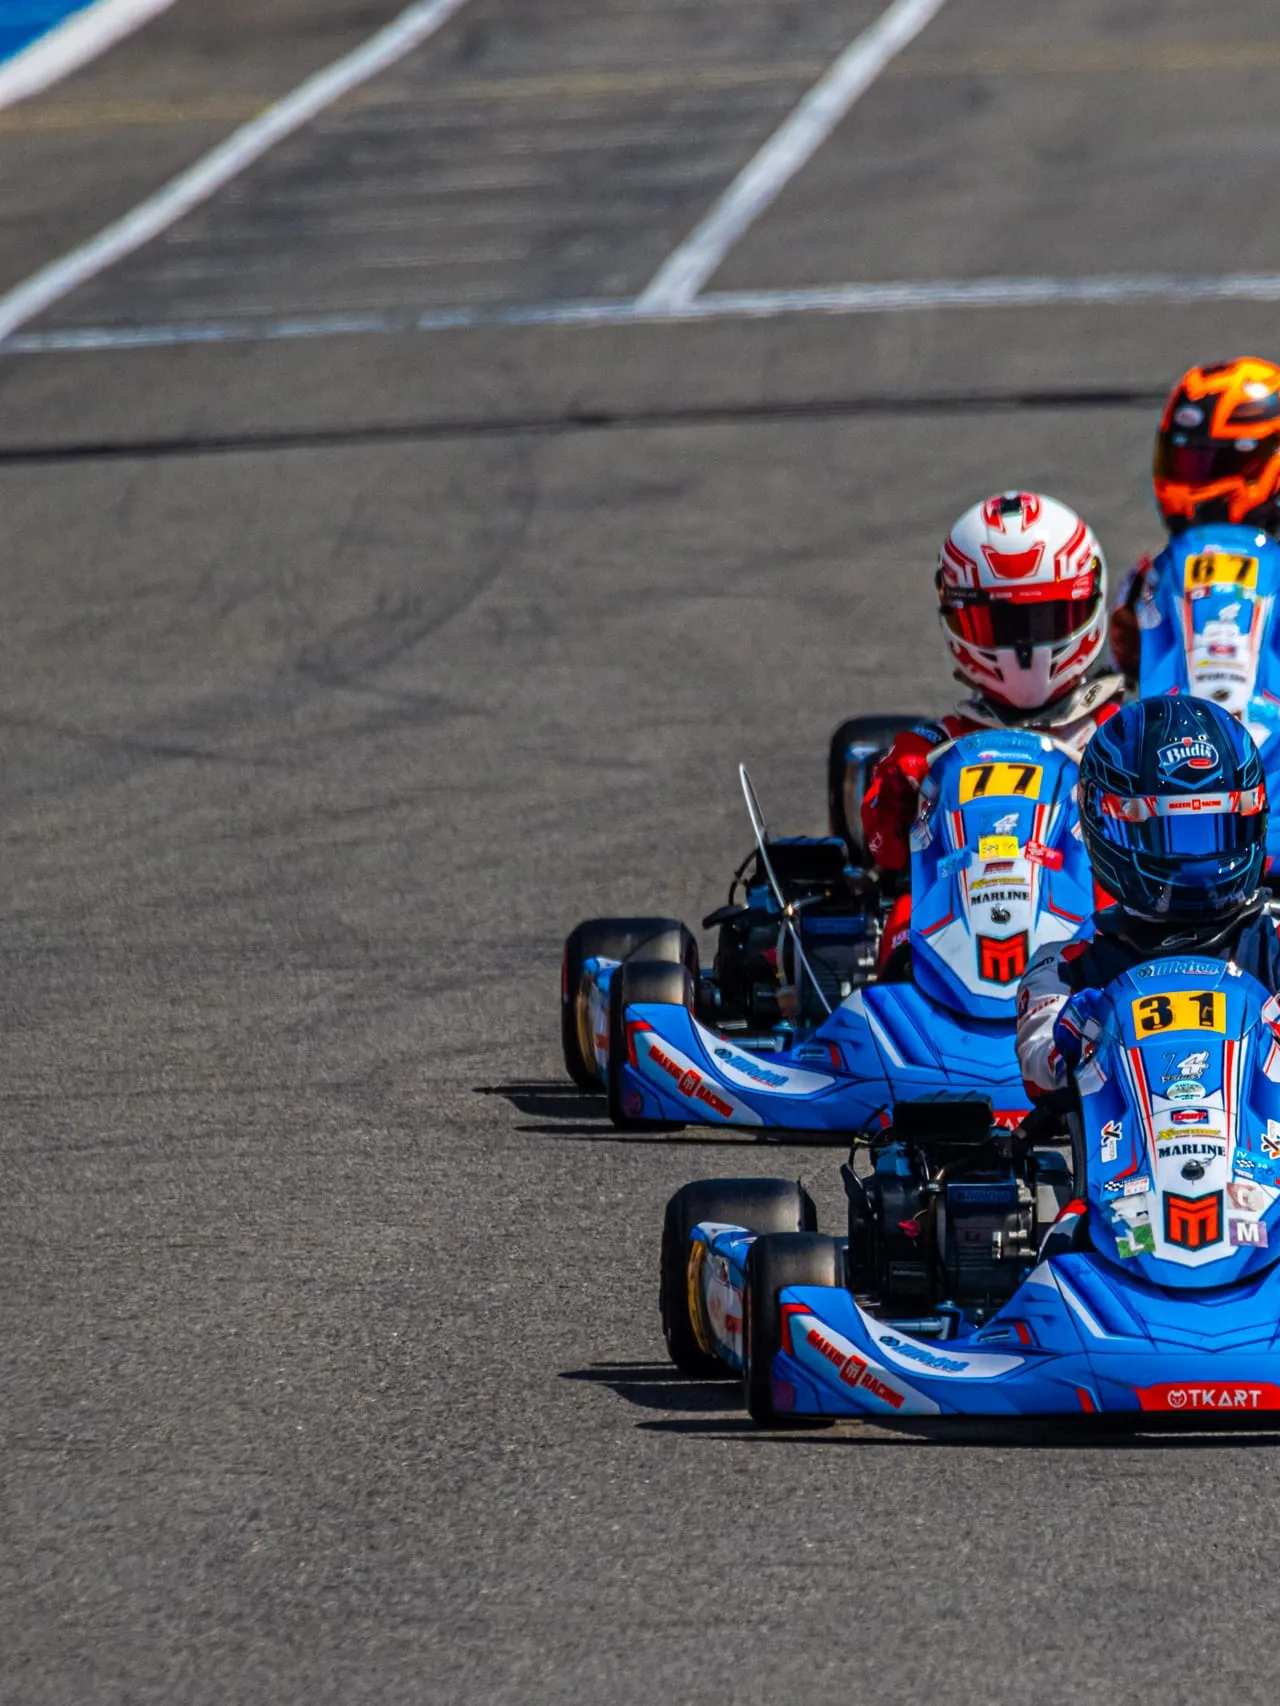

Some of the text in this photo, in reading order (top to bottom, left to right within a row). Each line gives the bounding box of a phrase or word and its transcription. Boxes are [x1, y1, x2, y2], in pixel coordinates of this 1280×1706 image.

[966, 764, 1037, 798] 77
[971, 891, 1029, 906] MARLINE
[1139, 992, 1214, 1031] 31
[1158, 1143, 1226, 1159] MARLINE
